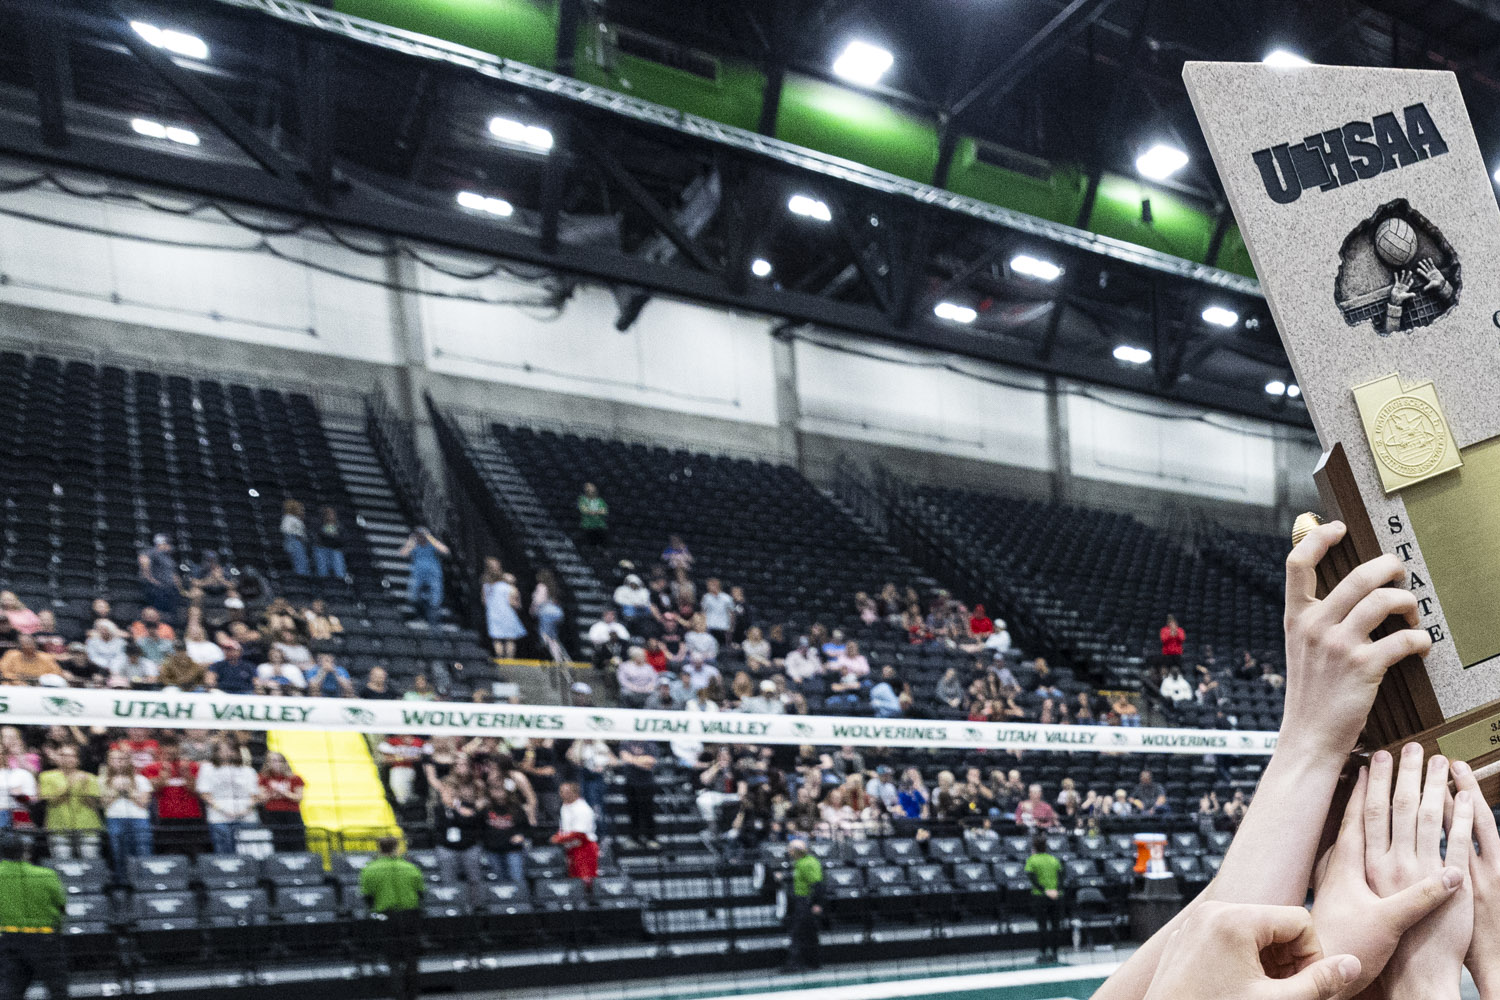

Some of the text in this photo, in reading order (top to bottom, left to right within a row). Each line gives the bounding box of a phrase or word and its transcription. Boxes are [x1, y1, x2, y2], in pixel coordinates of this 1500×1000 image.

[1387, 515, 1444, 644] STATE
[113, 699, 197, 719] UTAH
[210, 703, 313, 722] VALLEY
[402, 709, 564, 729] WOLVERINES
[634, 717, 689, 733] UTAH
[700, 720, 771, 735] VALLEY
[832, 724, 948, 740] WOLVERINES
[997, 729, 1037, 743] UTAH
[1044, 731, 1097, 745] VALLEY
[1142, 733, 1227, 748] WOLVERINES
